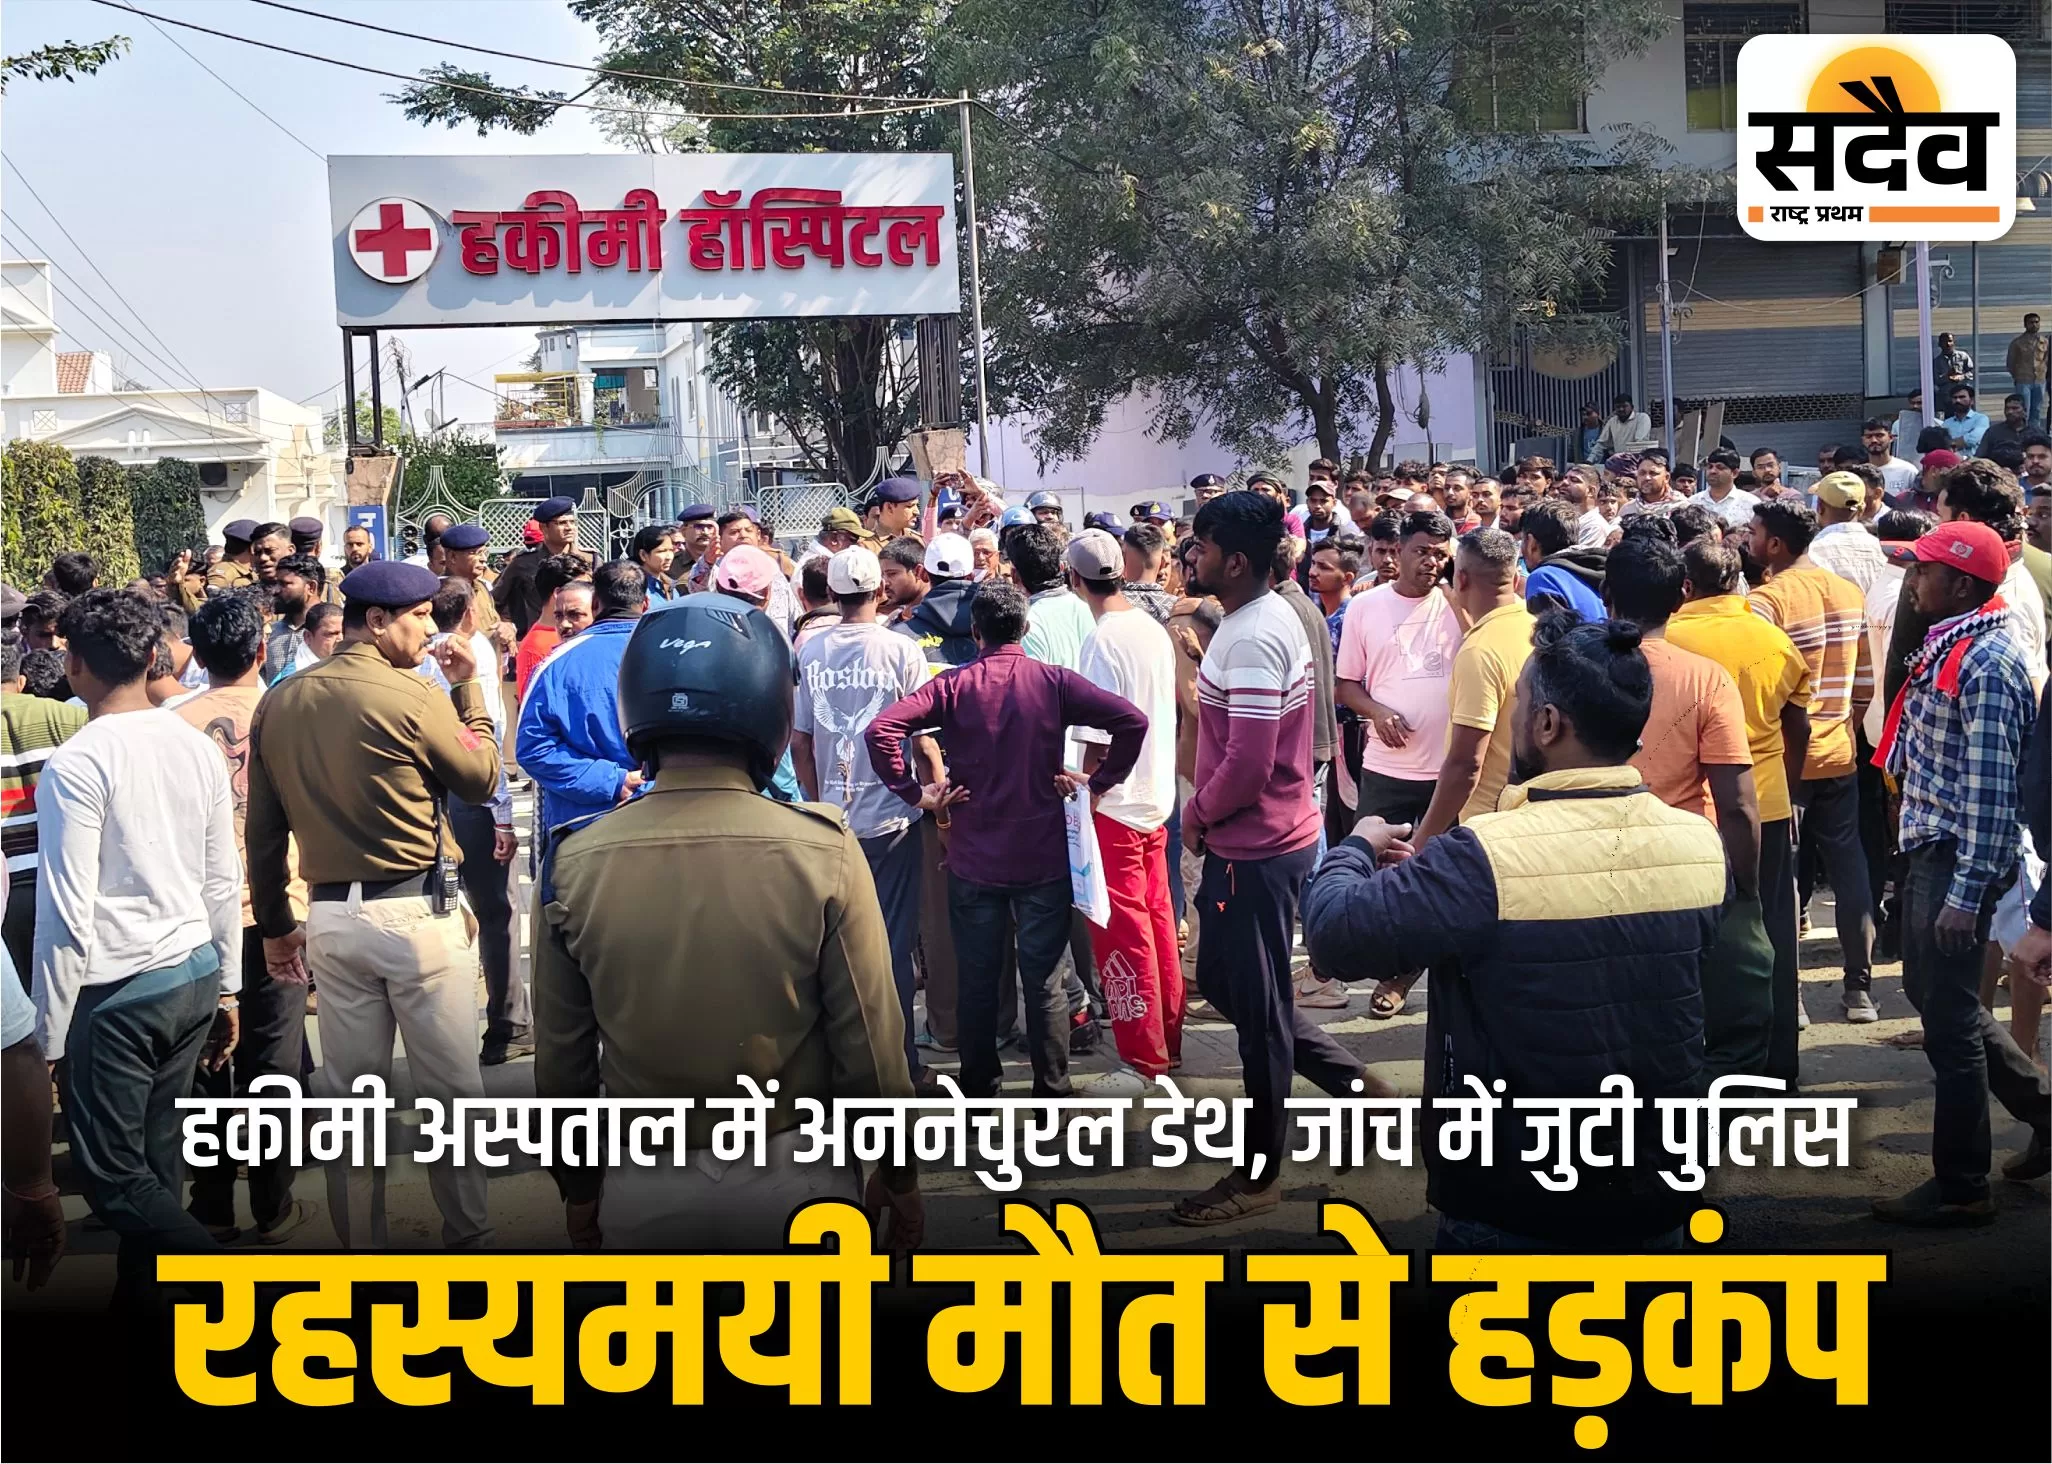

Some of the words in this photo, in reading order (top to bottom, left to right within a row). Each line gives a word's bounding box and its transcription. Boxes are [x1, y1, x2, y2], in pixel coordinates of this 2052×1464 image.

[452, 189, 667, 275] हकीमी
[680, 187, 945, 271] हॉस्पिटल
[804, 657, 896, 698] Boston
